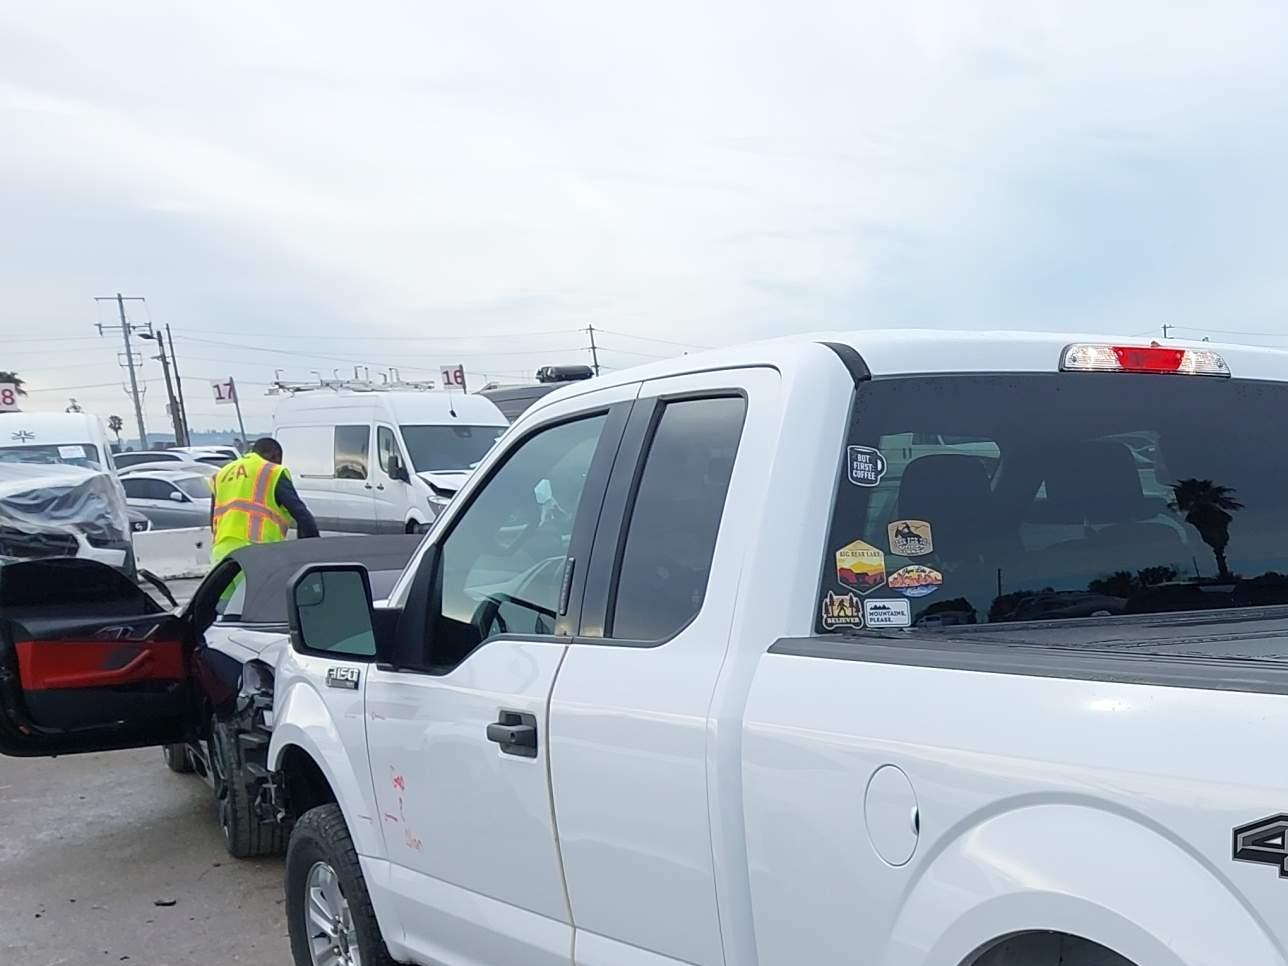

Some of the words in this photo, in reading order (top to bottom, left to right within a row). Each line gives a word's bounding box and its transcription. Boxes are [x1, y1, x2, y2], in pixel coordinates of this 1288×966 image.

[442, 369, 464, 386] 16
[212, 382, 235, 400] 17
[857, 454, 871, 463] BUT
[853, 461, 873, 472] FIRST
[853, 470, 876, 481] COFFEE
